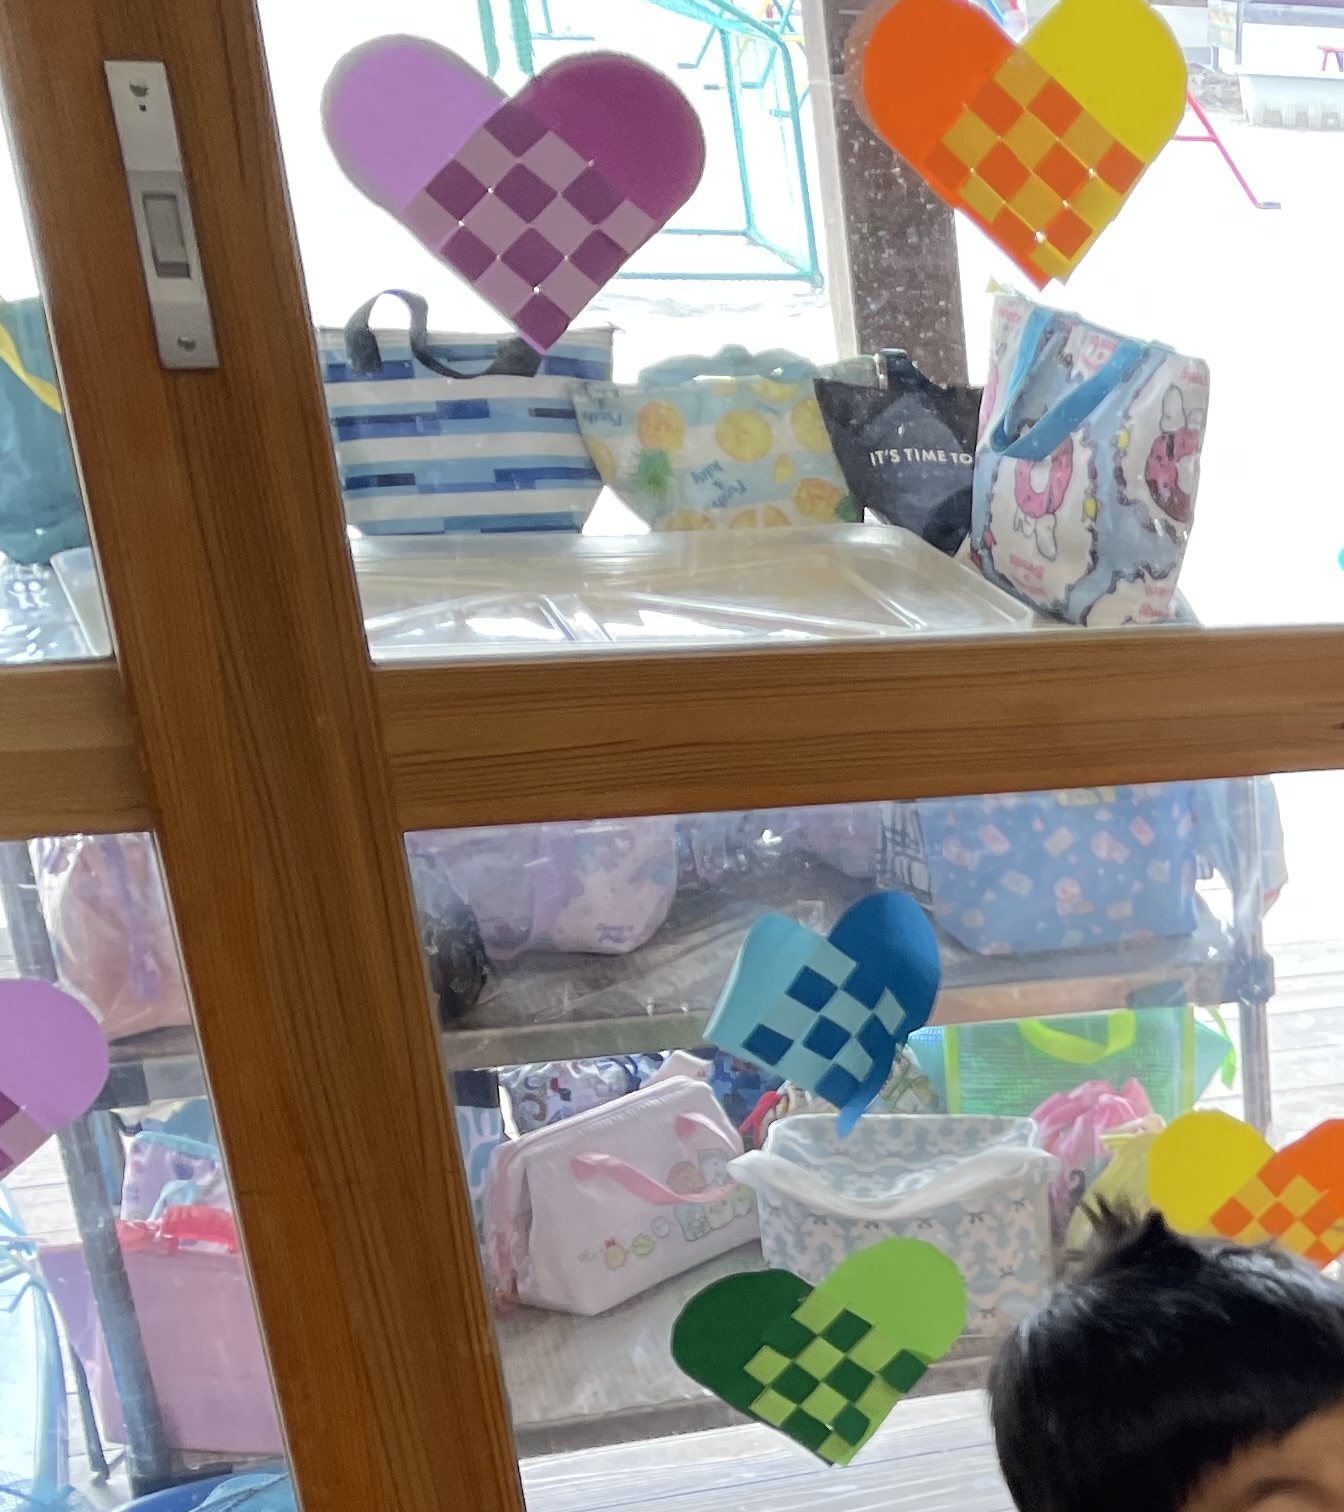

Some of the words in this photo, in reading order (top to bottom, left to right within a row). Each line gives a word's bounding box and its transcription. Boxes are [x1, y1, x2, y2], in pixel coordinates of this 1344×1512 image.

[869, 449, 900, 467] IT'S
[903, 448, 947, 462] TIME
[950, 452, 973, 464] TO
